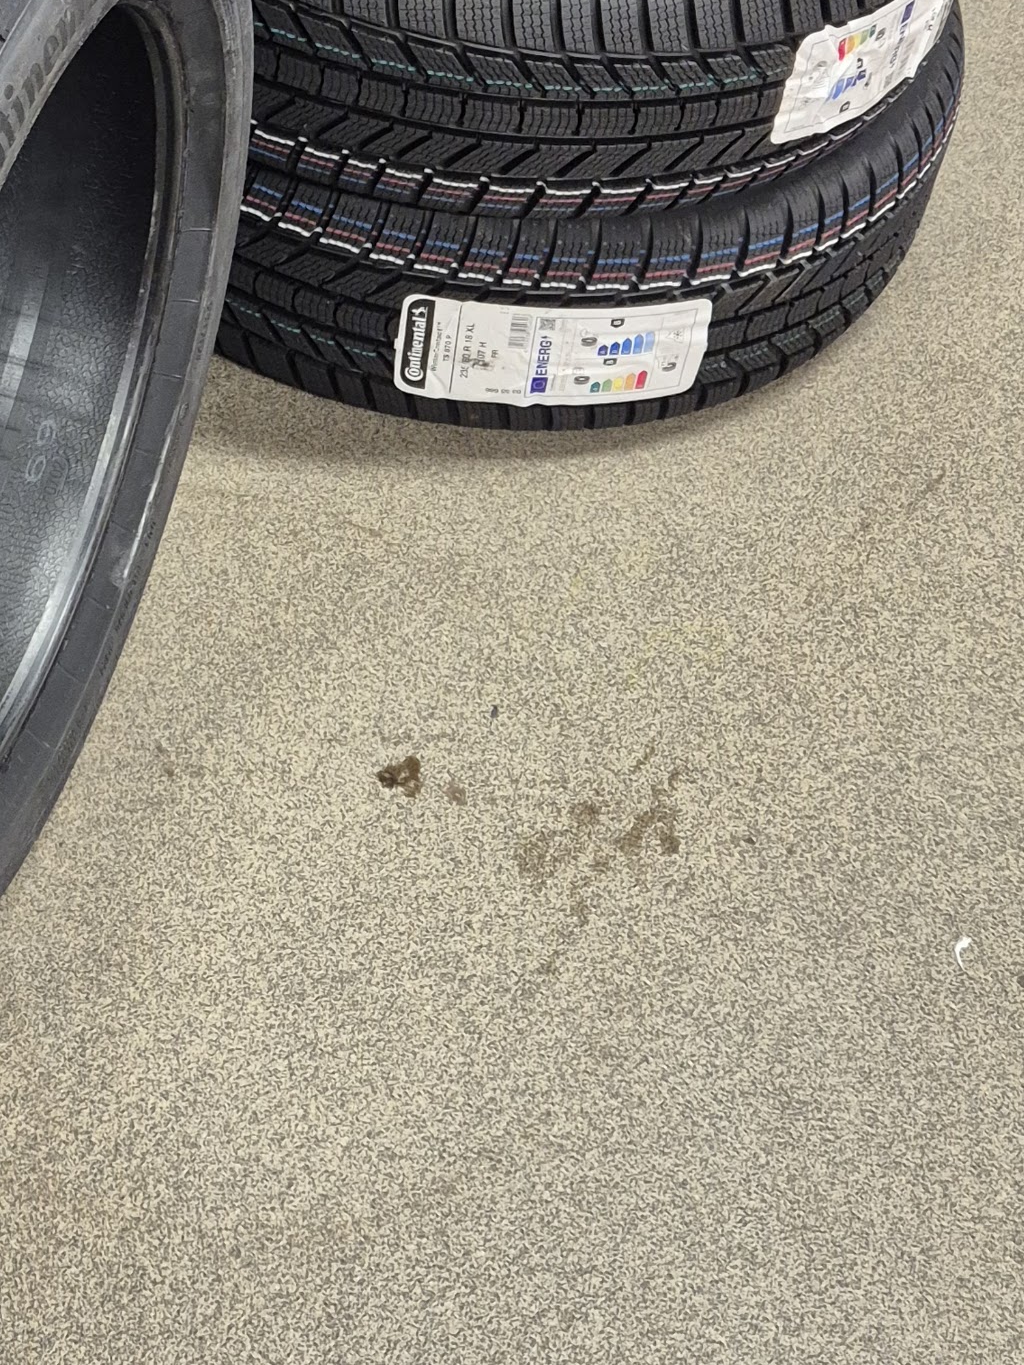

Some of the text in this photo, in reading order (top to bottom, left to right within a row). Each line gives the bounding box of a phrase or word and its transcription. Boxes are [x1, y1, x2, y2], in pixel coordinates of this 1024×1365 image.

[466, 323, 475, 334] XL
[465, 335, 473, 344] 18
[404, 316, 427, 381] Continental
[444, 340, 452, 353] 870
[535, 339, 553, 377] ENERG
